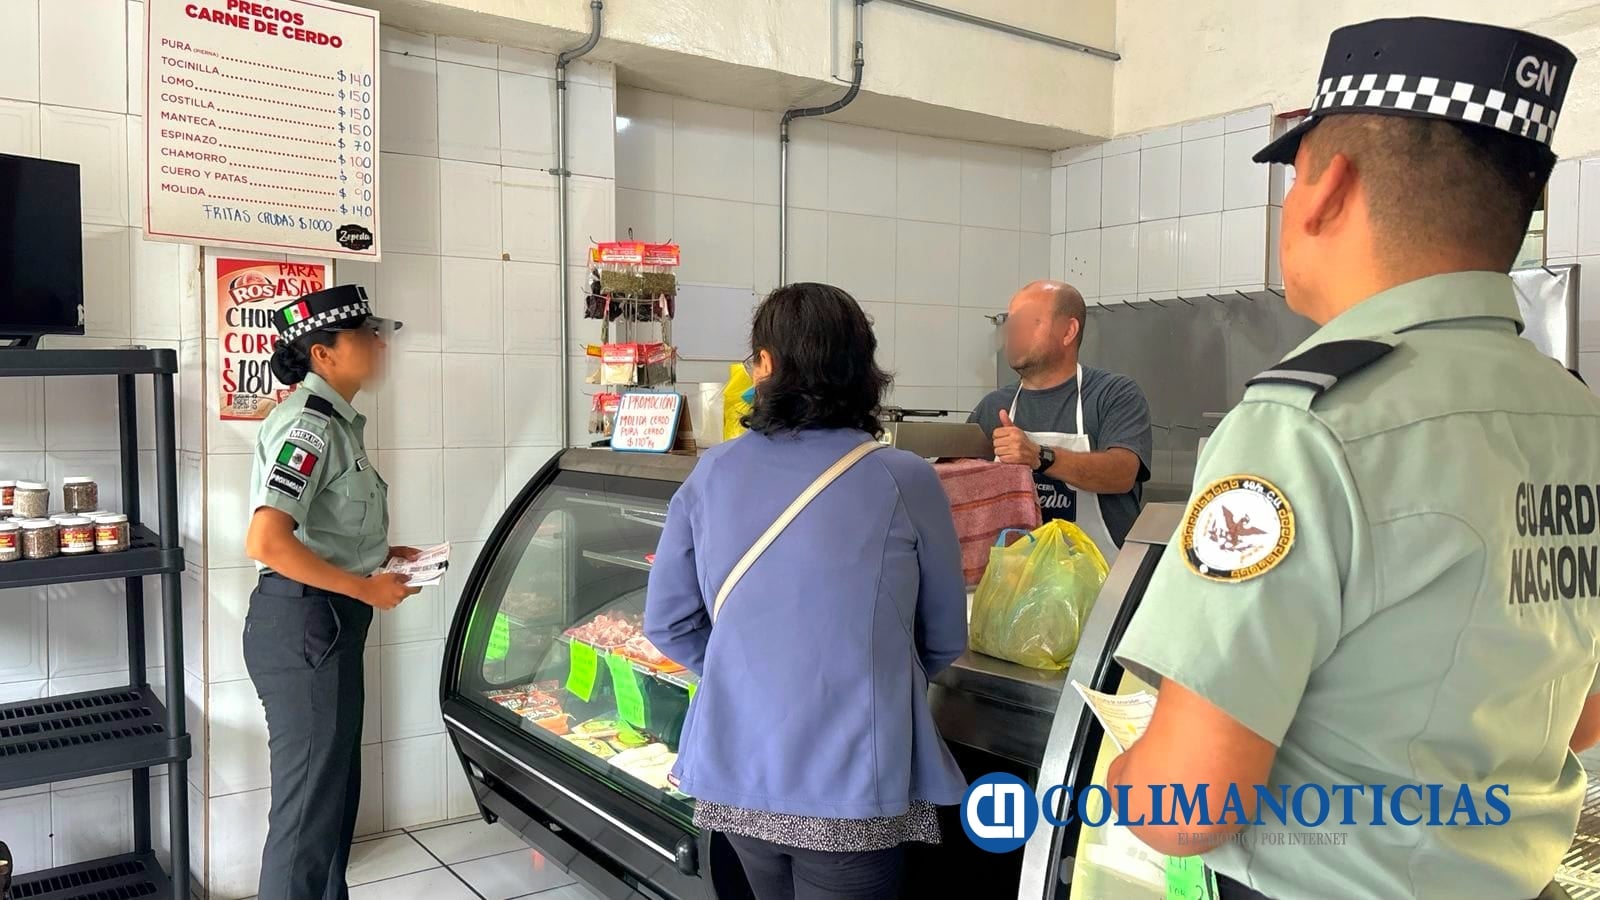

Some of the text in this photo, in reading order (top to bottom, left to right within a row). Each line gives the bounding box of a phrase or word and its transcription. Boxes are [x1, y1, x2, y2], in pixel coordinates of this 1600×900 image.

[227, 0, 305, 26] PRECIOS
[185, 4, 343, 48] CARNE DE CERDO
[161, 38, 192, 52] PURA
[161, 56, 220, 76] TOCINILLA
[161, 75, 194, 88] LOMO
[1516, 55, 1558, 96] GN
[160, 93, 215, 110] COSTILLA
[161, 111, 216, 128] MANTECA
[161, 130, 218, 145] ESPINAZO
[160, 147, 227, 164] CHAMORRO
[160, 165, 201, 178] CUERO
[204, 171, 212, 179] Y
[214, 172, 248, 184] PATAS
[161, 183, 206, 196] MOLIDA
[202, 204, 251, 223] FRITAS
[258, 211, 295, 228] CRUDAS
[340, 230, 370, 244] Zepeda
[279, 262, 318, 278] PARA
[232, 285, 275, 300] ROS
[620, 415, 647, 426] MOLIDA
[1039, 490, 1071, 508] eda
[1508, 546, 1600, 605] NACION
